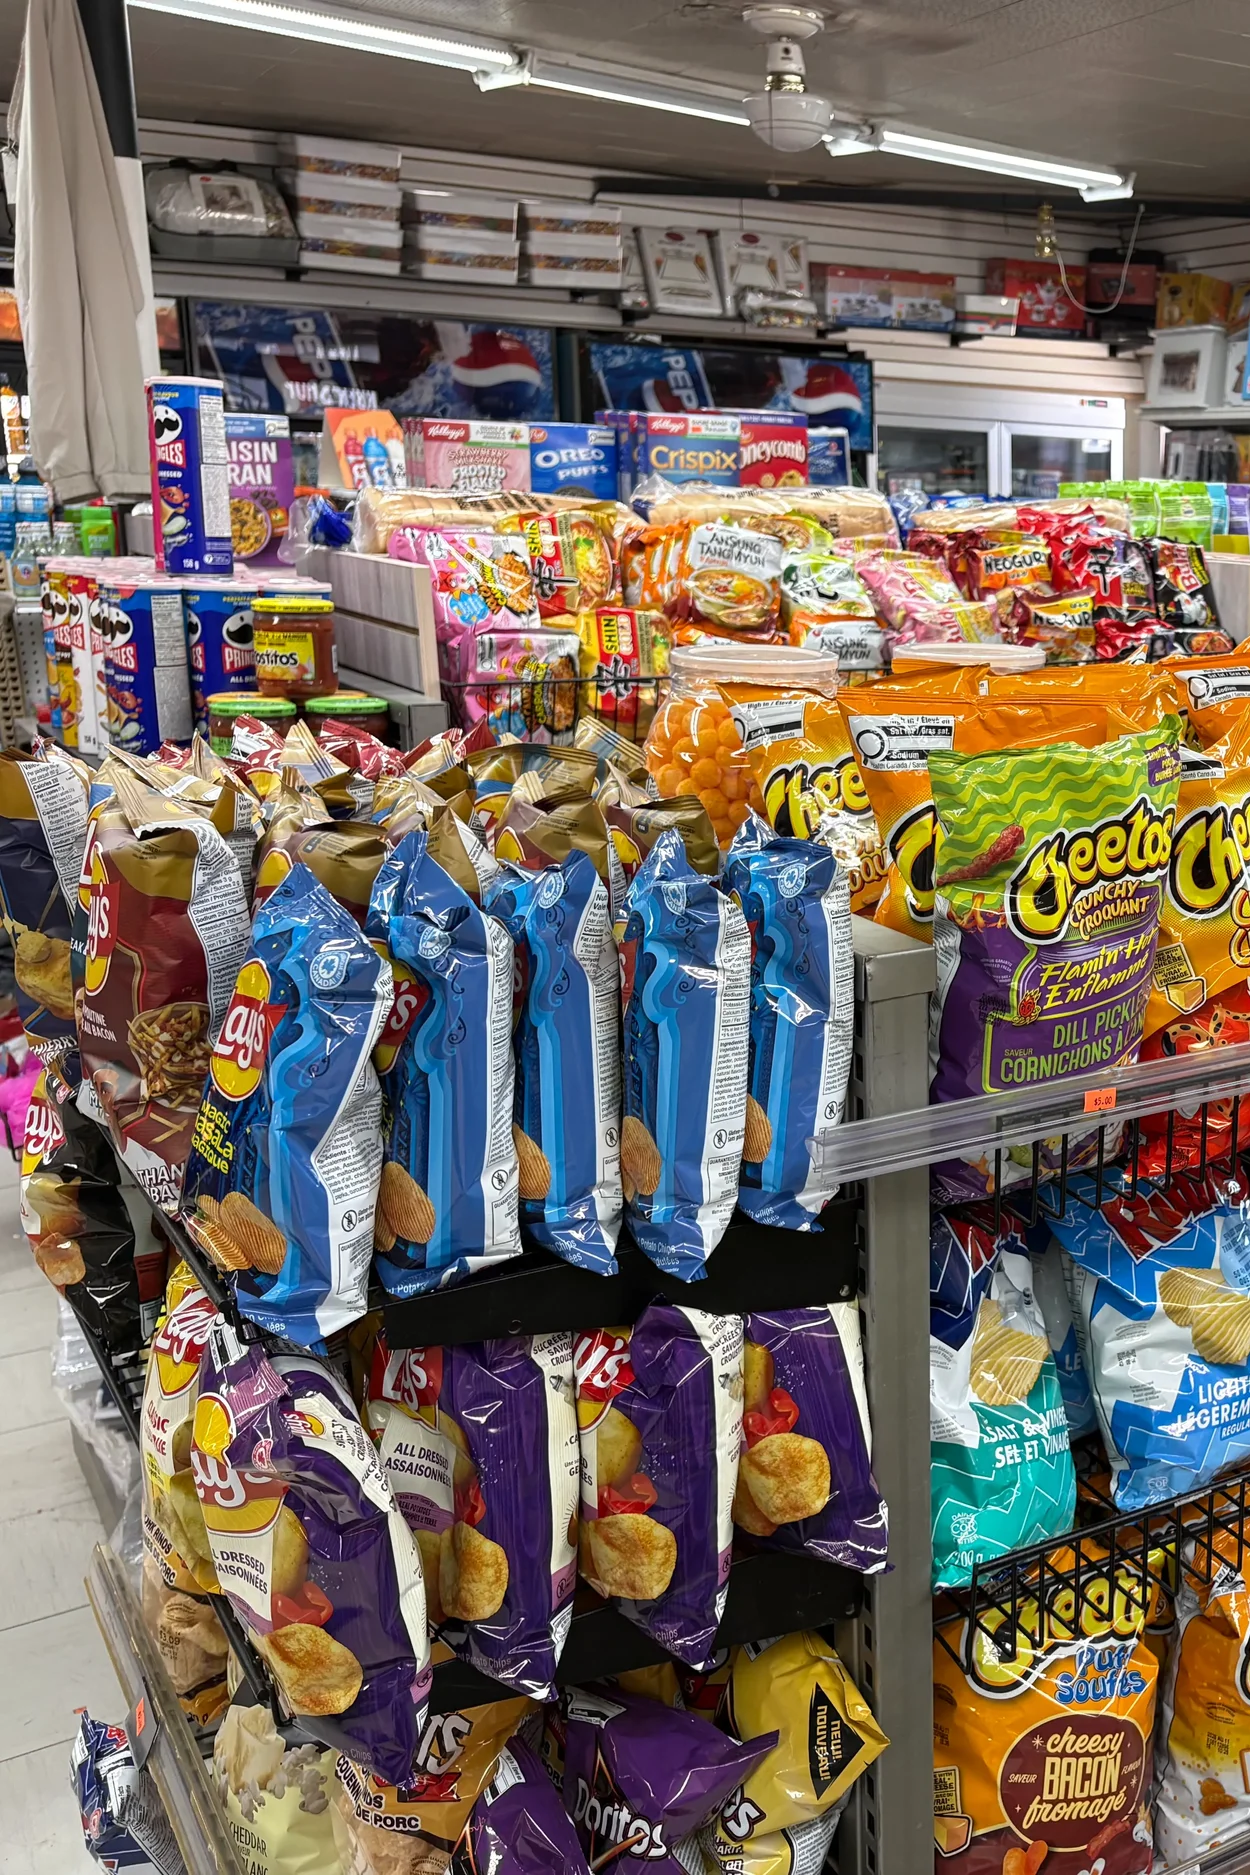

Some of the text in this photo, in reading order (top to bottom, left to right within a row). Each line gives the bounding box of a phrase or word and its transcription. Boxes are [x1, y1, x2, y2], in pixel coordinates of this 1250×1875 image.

[428, 424, 465, 440] Kellogg's
[651, 420, 685, 434] Kellogg's
[535, 448, 605, 469] OREO
[651, 446, 737, 473] Crispix
[228, 464, 272, 486] RAN
[605, 615, 619, 653] SHIN
[1017, 805, 1173, 936] Cheetos
[1070, 880, 1141, 928] CRUNCHY
[1079, 896, 1151, 941] CROQUANT
[92, 1023, 118, 1044] BACON
[213, 994, 266, 1070] Lay's
[1052, 1016, 1090, 1049] DILL
[1000, 1038, 1113, 1084] CORNICHONS
[1004, 1048, 1034, 1057] SAVEUR
[1093, 1096, 1114, 1107] $5.00
[983, 1420, 1018, 1444] SALT
[393, 1441, 450, 1471] ALL DRESSED
[995, 1444, 1041, 1468] SEL ET
[383, 1456, 452, 1489] ASSAISONNÉES
[224, 1551, 266, 1576] DRESSED
[1046, 1725, 1125, 1762] cheesy
[1007, 1773, 1038, 1785] SAVEUR
[1042, 1752, 1122, 1801] BACON
[372, 1811, 421, 1831] PORC
[576, 1776, 670, 1859] Doritos
[1022, 1785, 1127, 1830] fromagé
